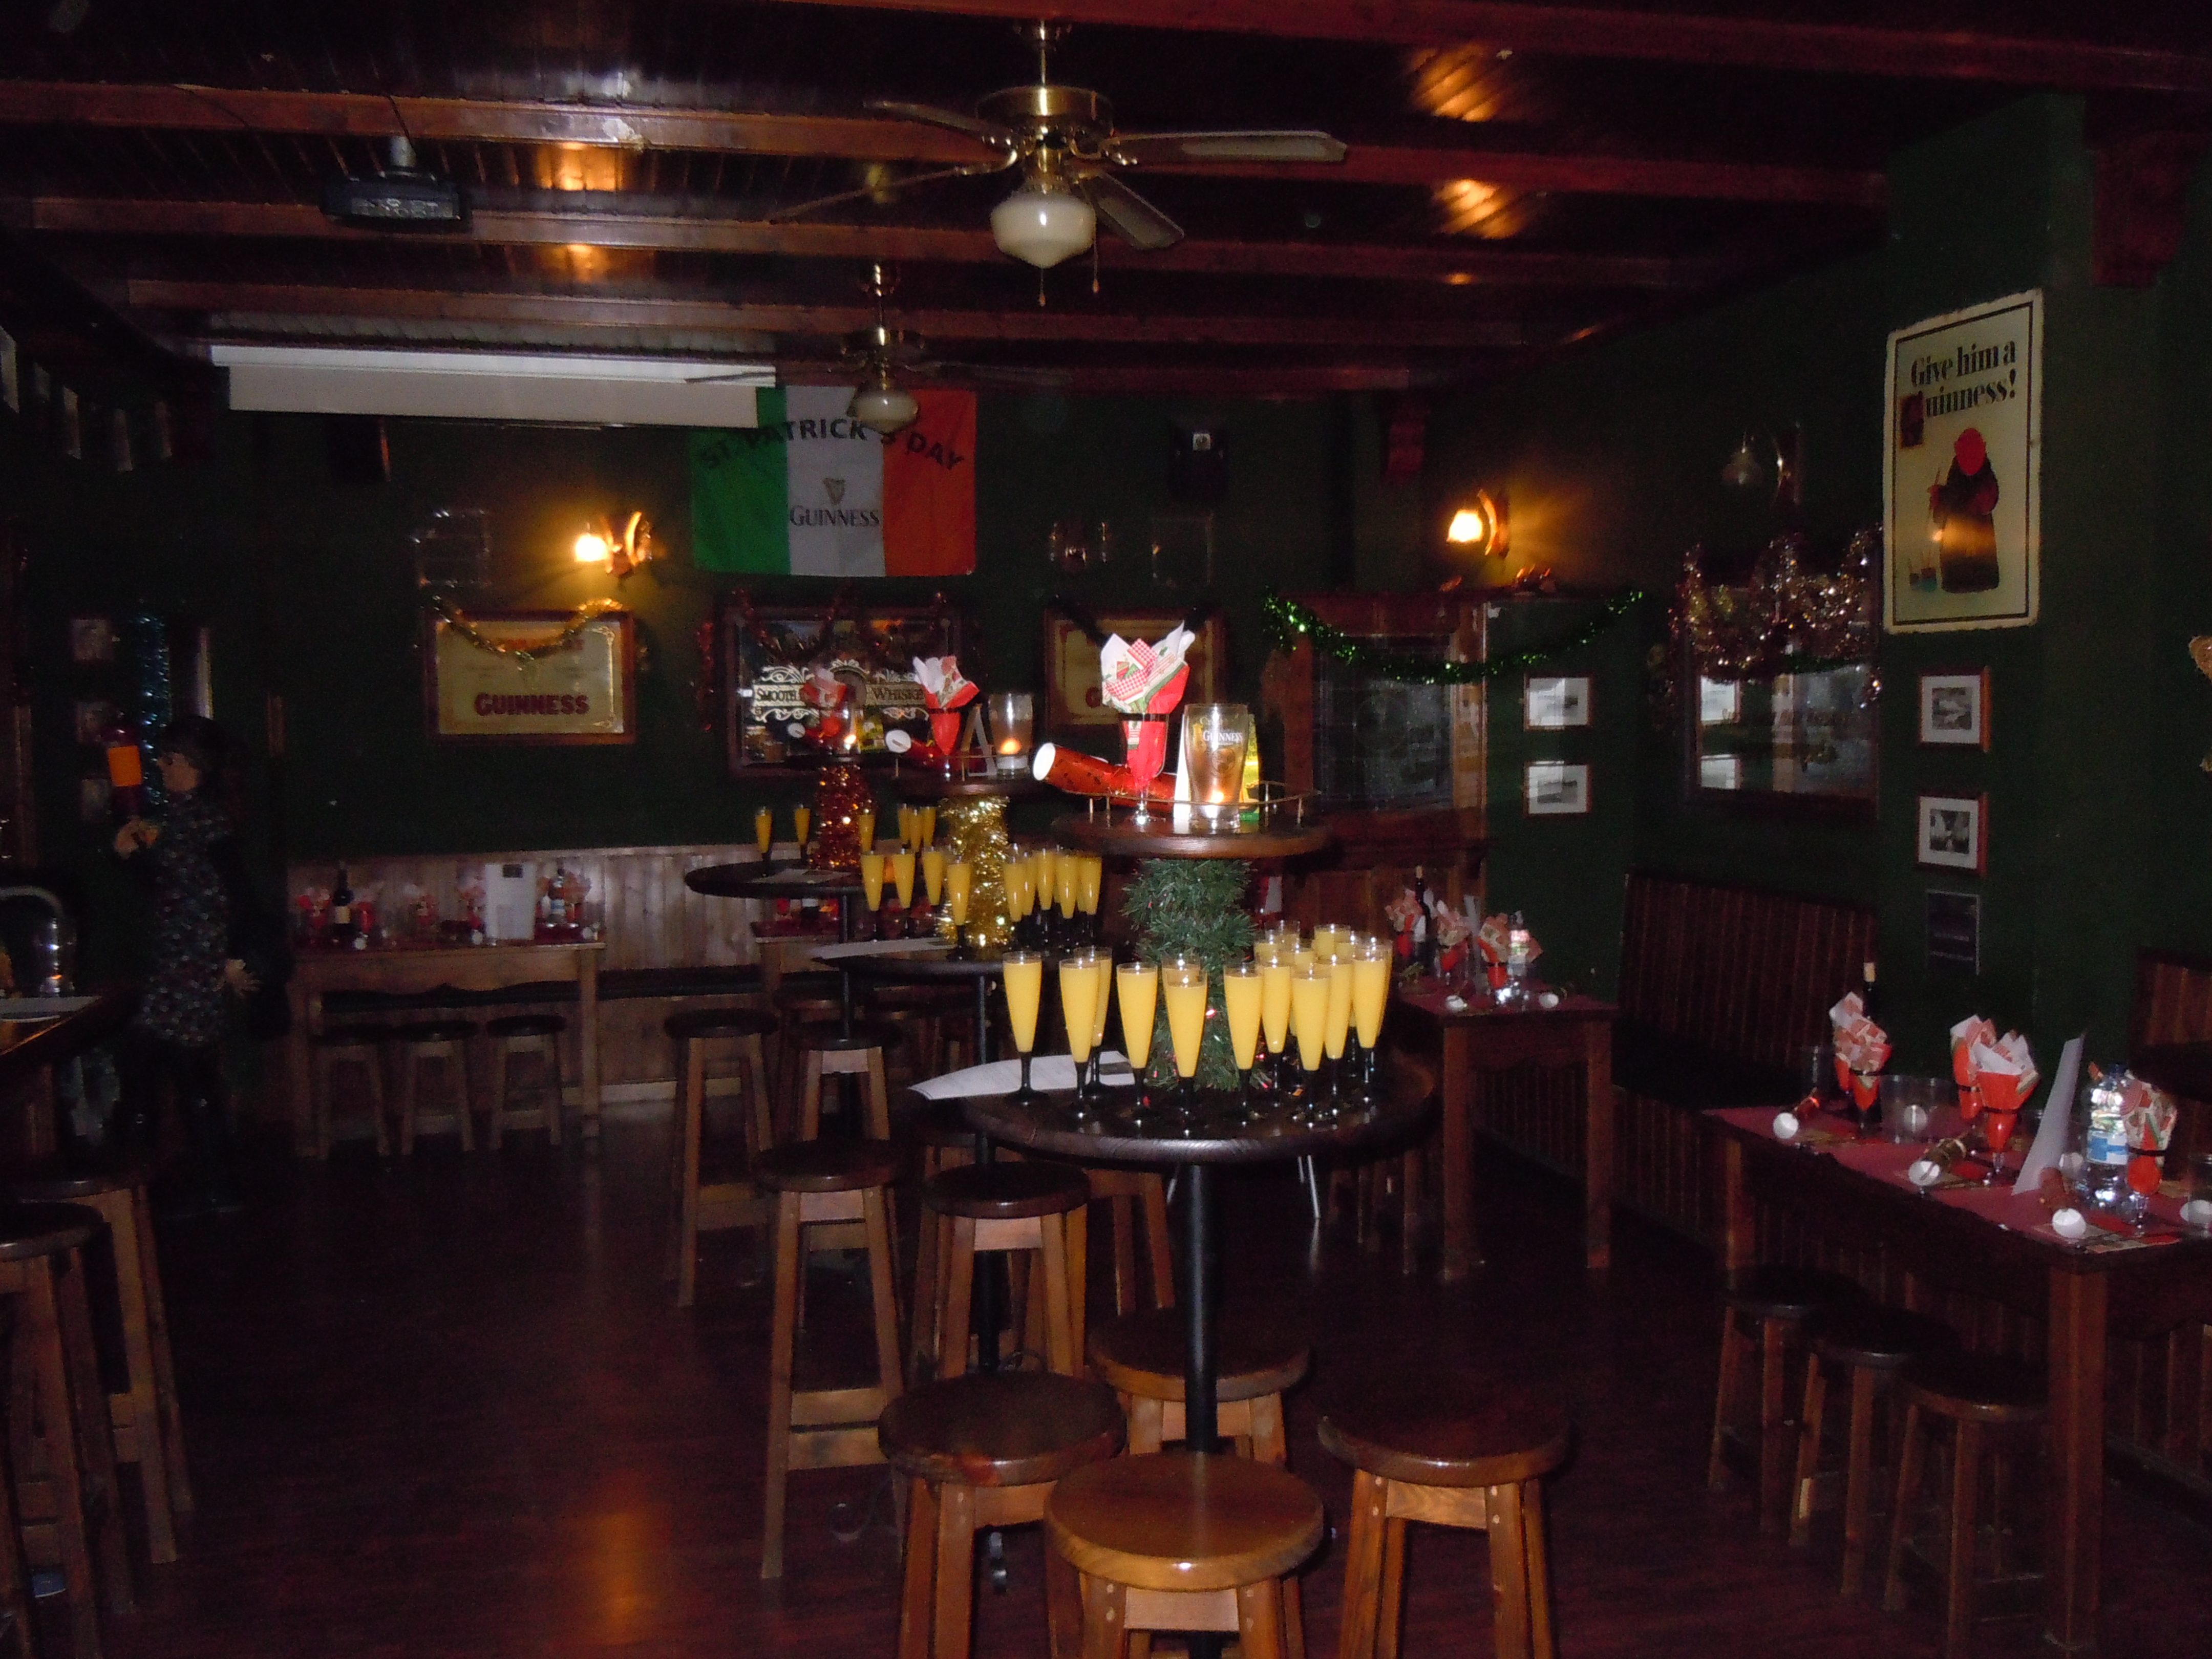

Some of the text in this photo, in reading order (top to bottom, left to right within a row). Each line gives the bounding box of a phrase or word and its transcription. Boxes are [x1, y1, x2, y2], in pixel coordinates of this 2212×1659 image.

[1911, 340, 2016, 387] Give him a
[905, 432, 965, 470] DAY
[790, 505, 880, 527] GUINNESS
[475, 692, 589, 716] GUINNESS
[1203, 730, 1243, 742] GUNNESS
